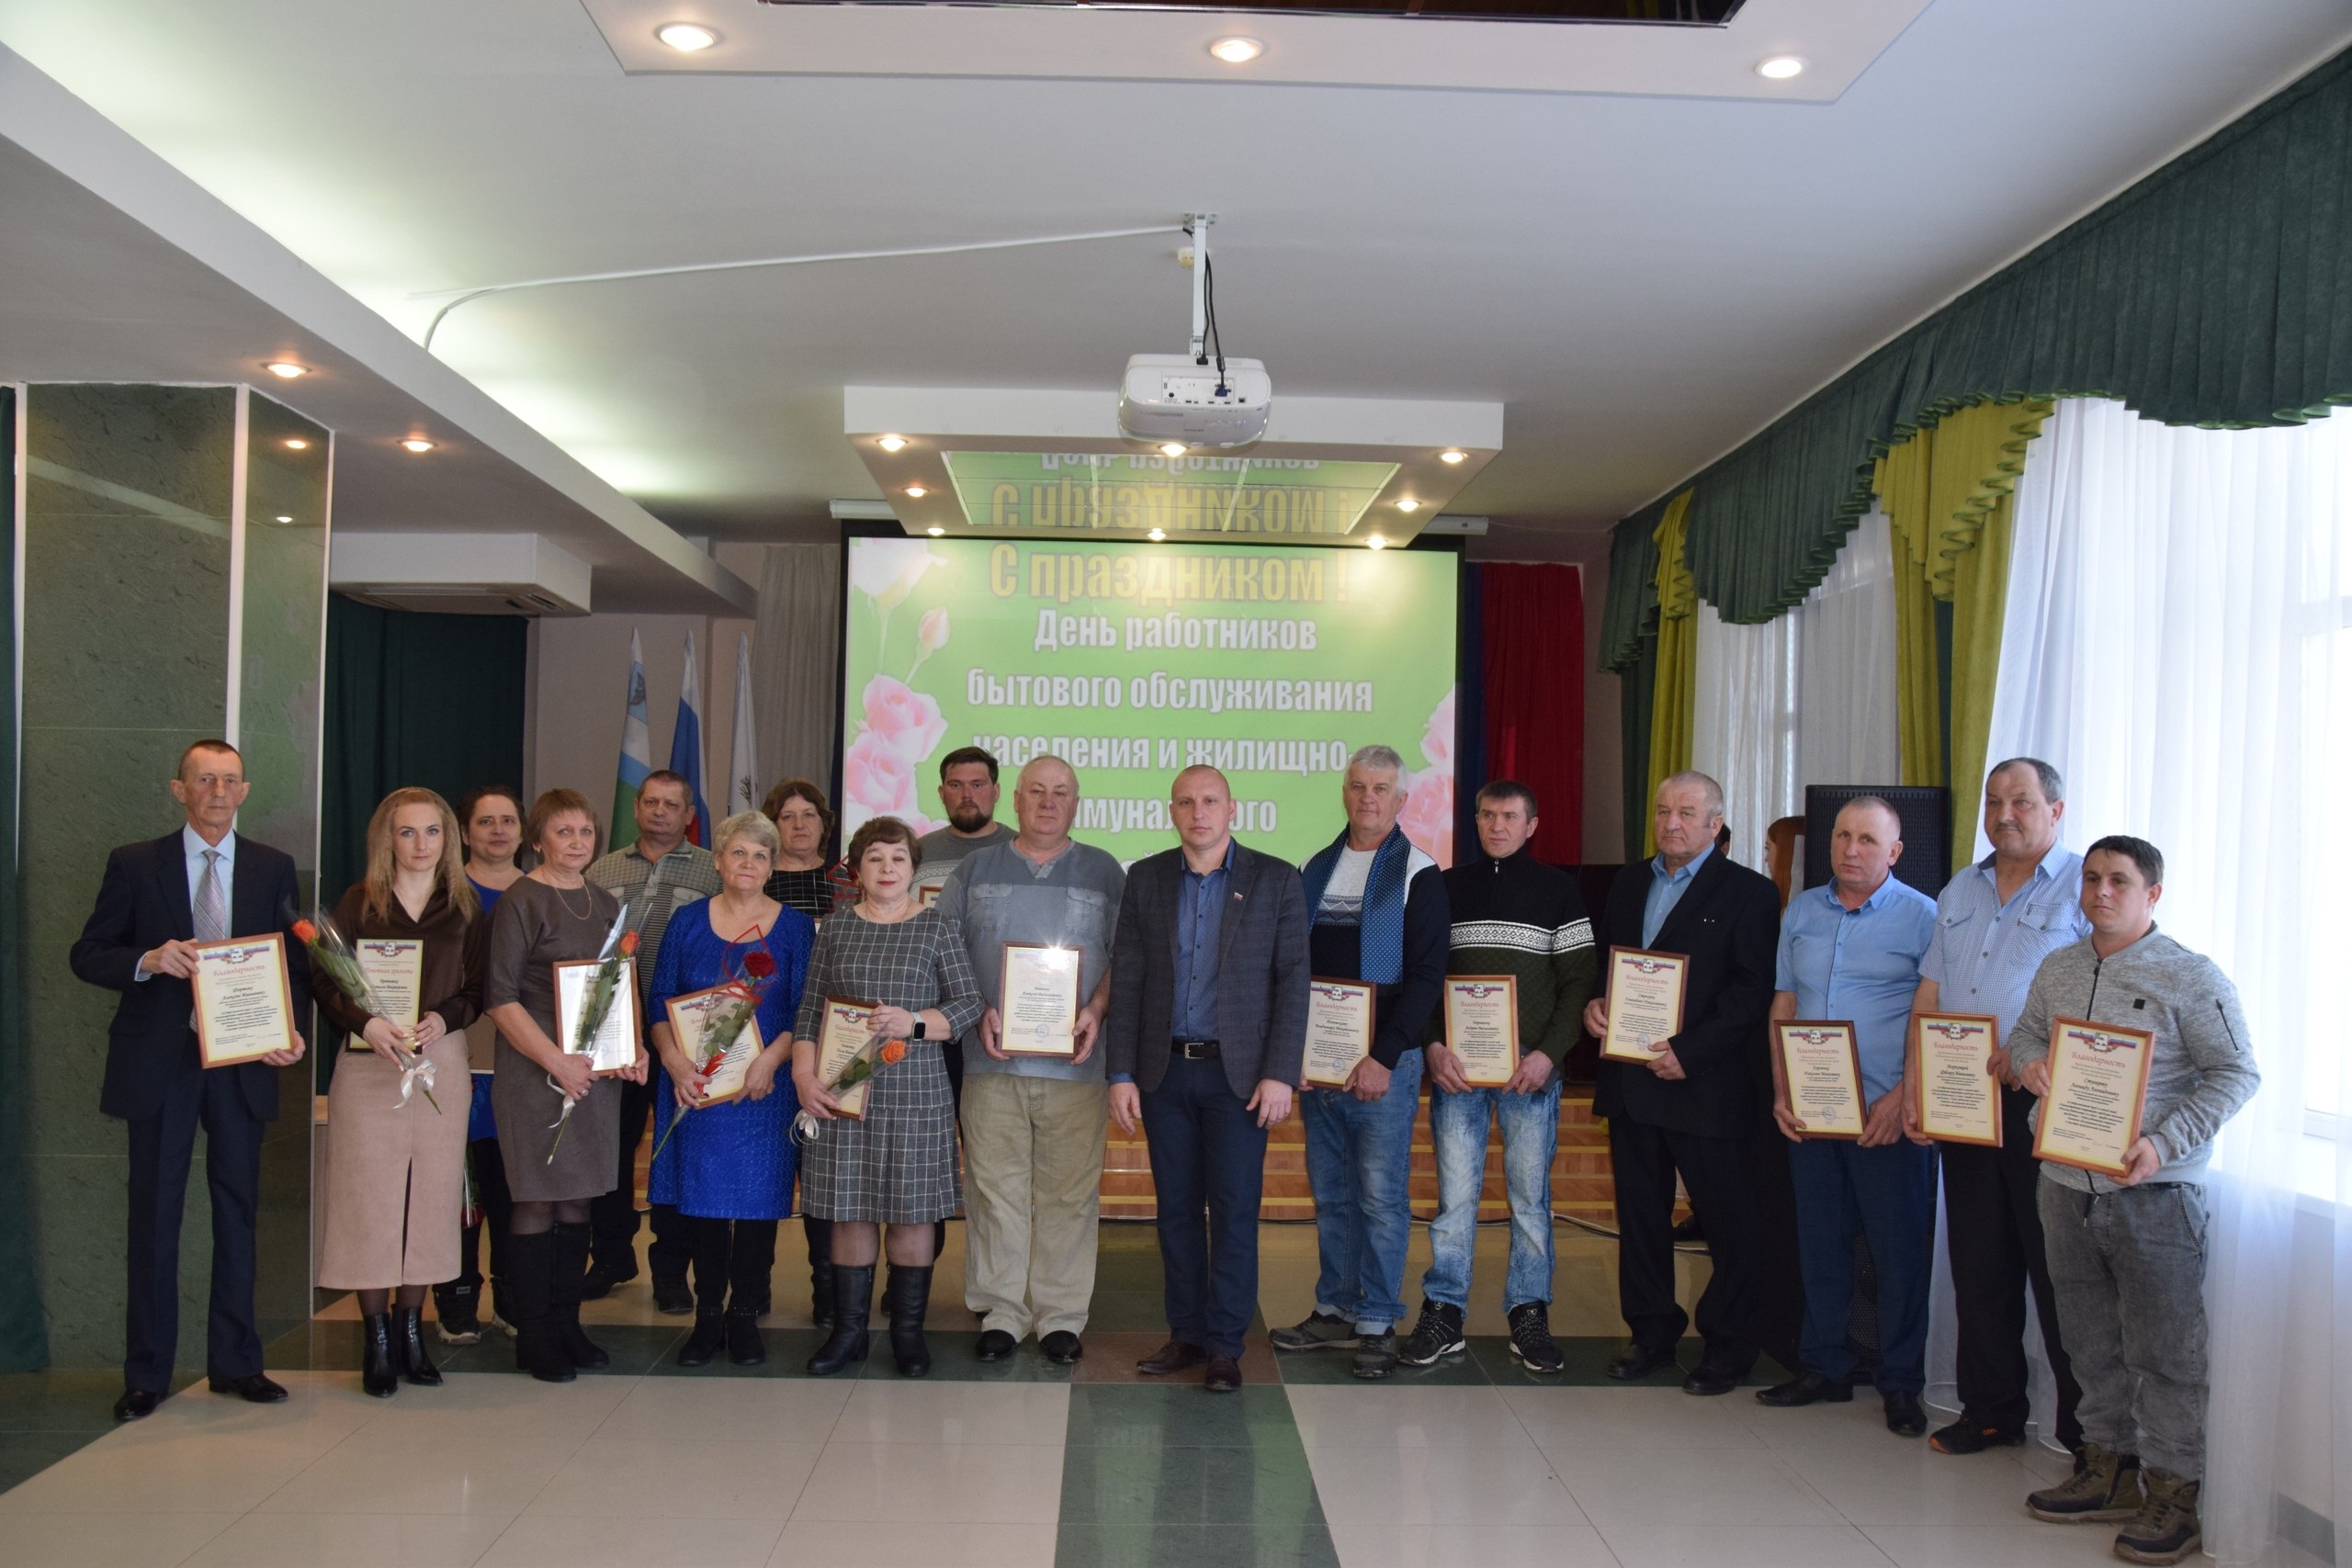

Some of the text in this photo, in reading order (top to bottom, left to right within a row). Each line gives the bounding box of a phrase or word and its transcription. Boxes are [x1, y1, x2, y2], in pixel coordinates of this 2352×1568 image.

[989, 542, 1019, 599] С
[1029, 551, 1325, 607] праздником
[1034, 608, 1318, 652] День работников
[967, 667, 1374, 715] бытового обслуживания
[1158, 738, 1179, 769] и
[1796, 1046, 1839, 1055] Благодарность
[1933, 1042, 1979, 1052] Благодарность
[2072, 1052, 2126, 1068] Благодарность
